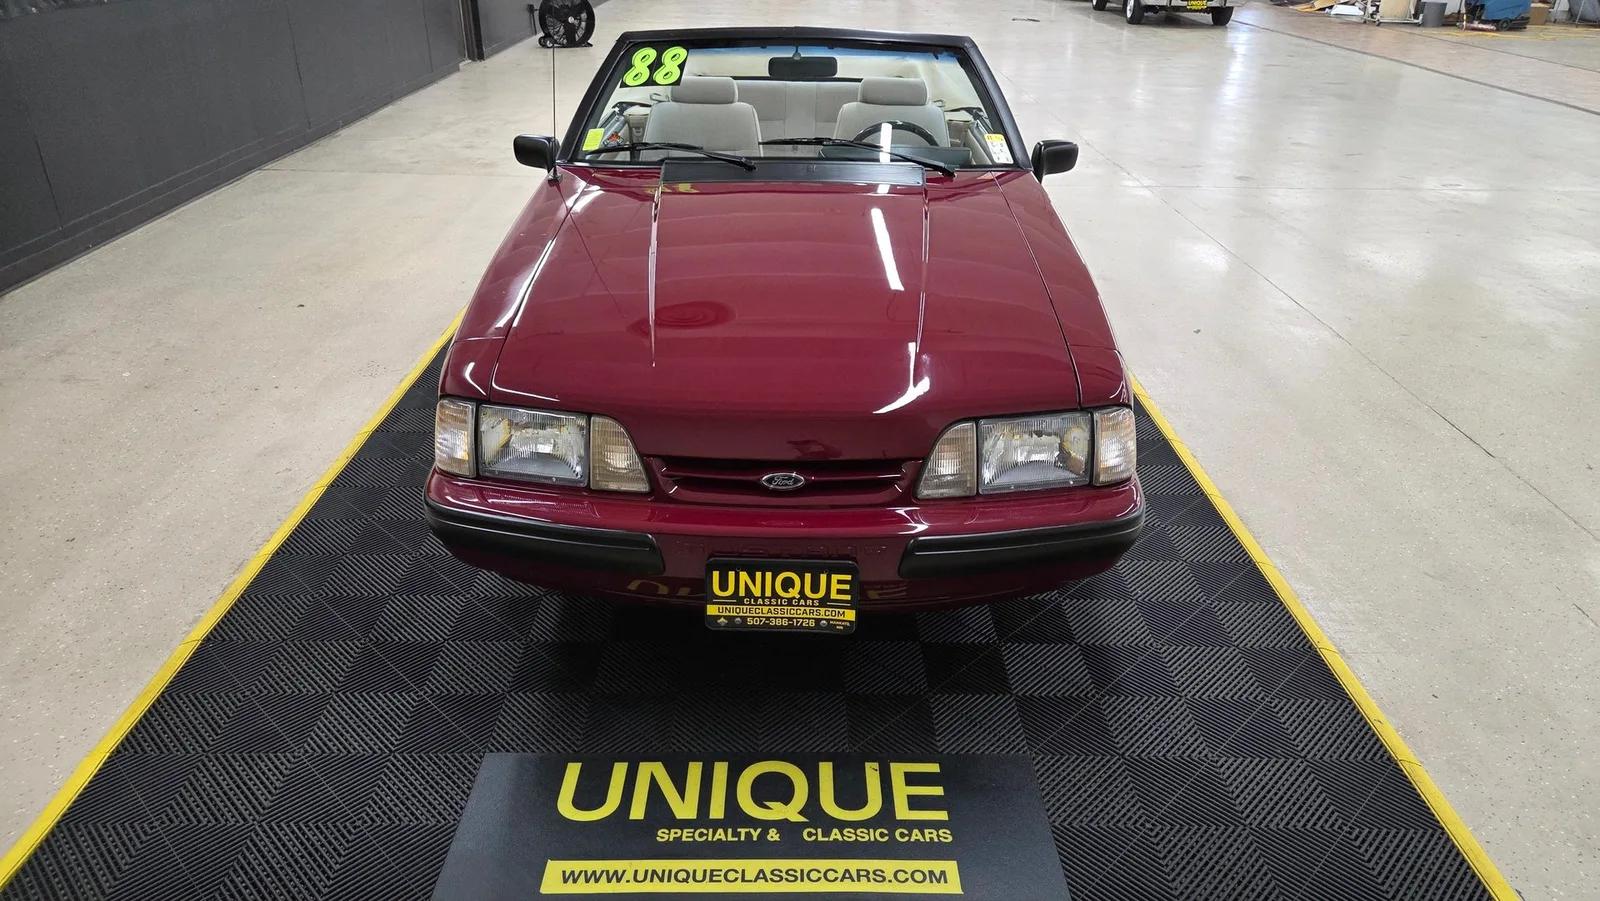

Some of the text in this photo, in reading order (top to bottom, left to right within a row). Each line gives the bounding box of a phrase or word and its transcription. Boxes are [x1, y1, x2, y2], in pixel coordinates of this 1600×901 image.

[623, 46, 688, 86] 88
[771, 475, 795, 486] Ford
[712, 570, 852, 600] UNIQUE
[743, 598, 820, 607] CLASSIC CARS
[717, 606, 846, 618] UNIQUECLASSICCARS.COM
[747, 617, 816, 627] 507-386-1726
[557, 761, 949, 822] UNIQUE
[656, 828, 953, 843] SPECIALTY & CLASSIC CARS
[562, 868, 948, 884] WWW.UNIQUECLASSICCARS.COM
